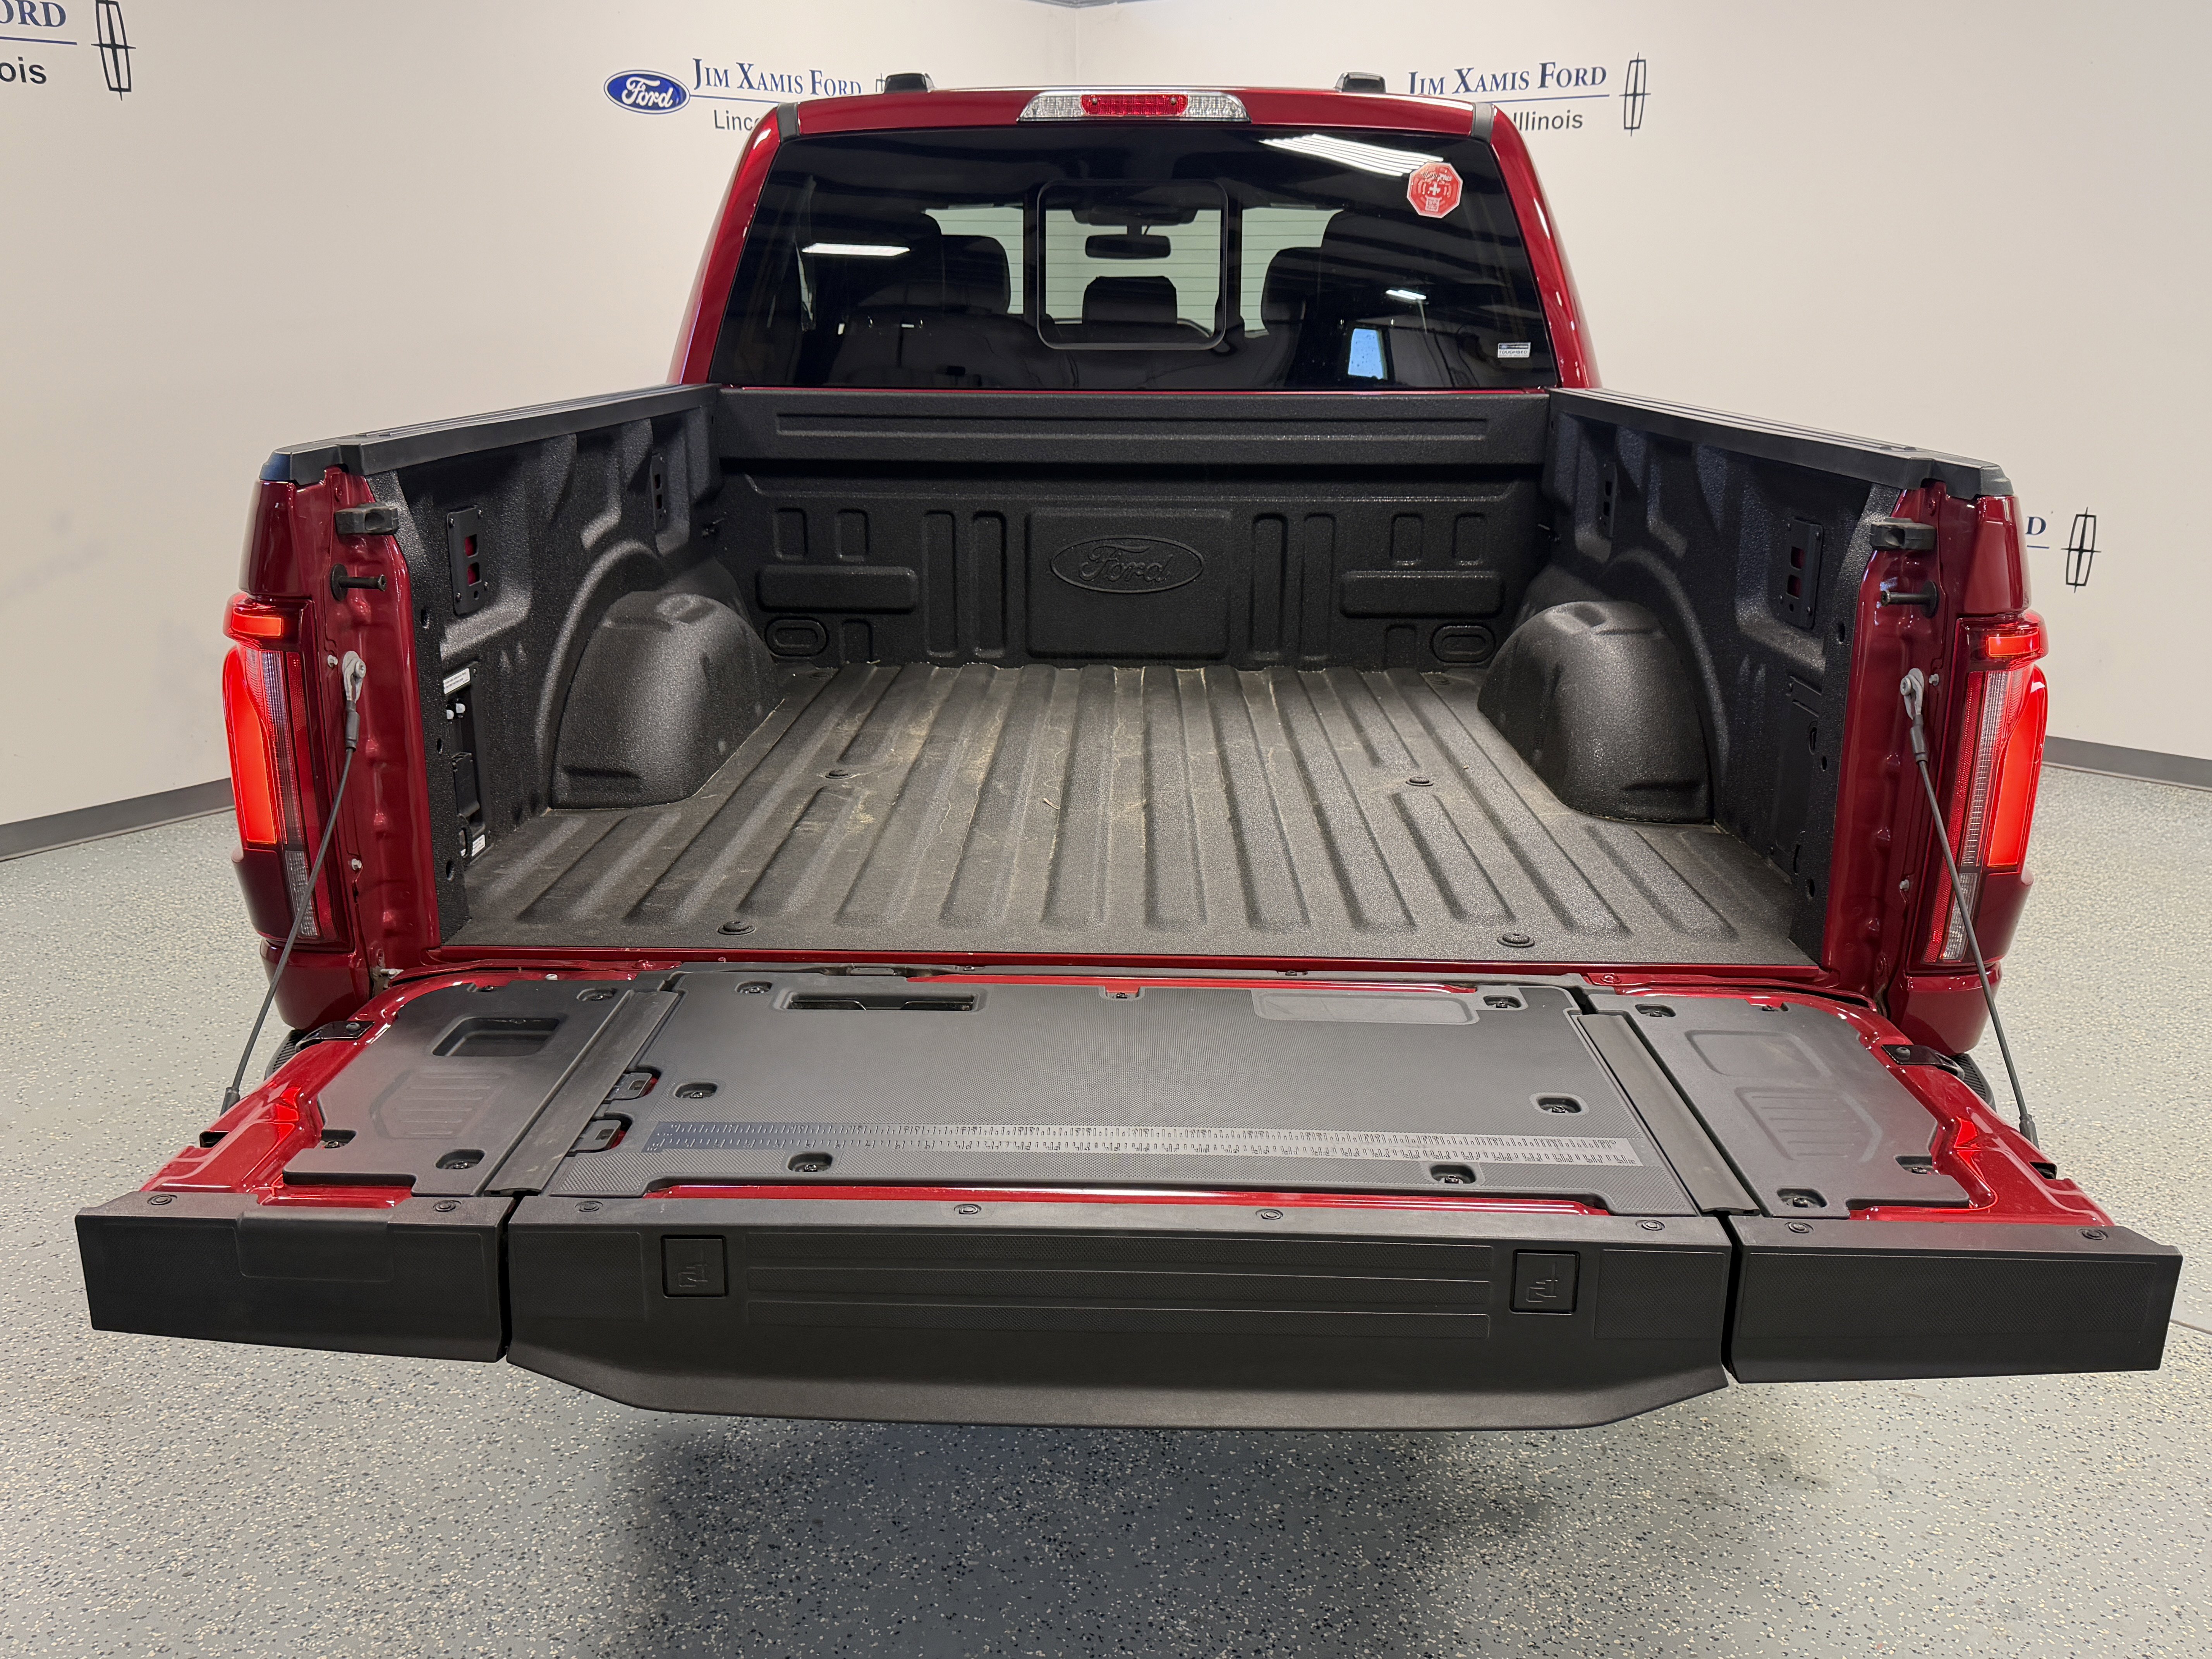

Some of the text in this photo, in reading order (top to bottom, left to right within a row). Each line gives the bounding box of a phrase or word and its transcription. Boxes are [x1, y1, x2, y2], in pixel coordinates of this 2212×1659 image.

[621, 76, 673, 108] Ford
[692, 58, 862, 96] JIM XAMIS FORD
[1408, 62, 1607, 95] JIM XAMIS FORD
[1513, 110, 1583, 131] Illinois
[1079, 544, 1174, 582] Ford
